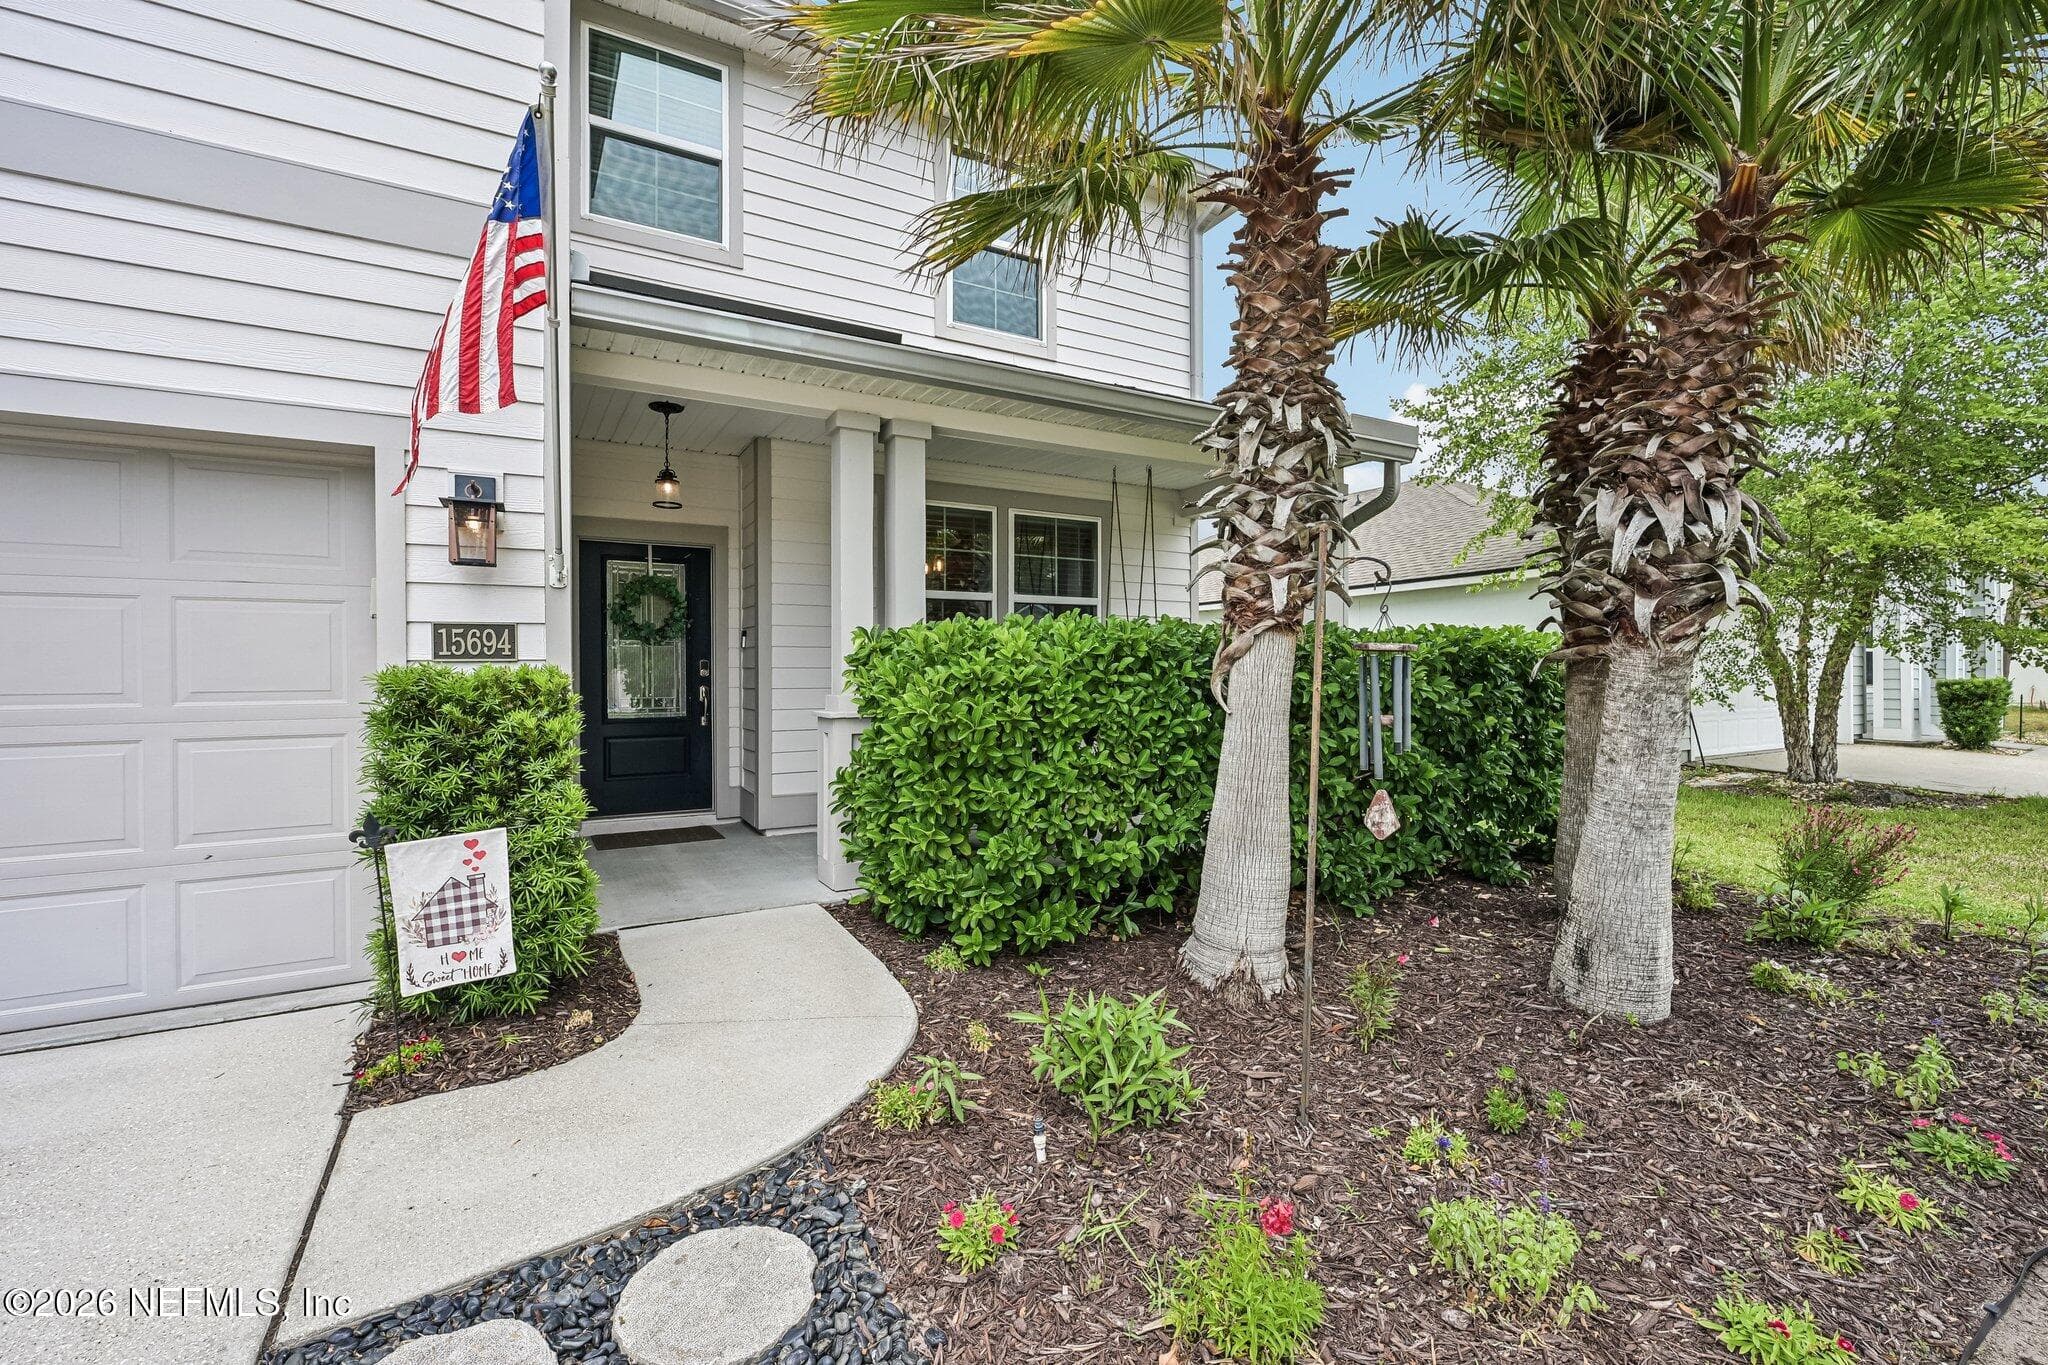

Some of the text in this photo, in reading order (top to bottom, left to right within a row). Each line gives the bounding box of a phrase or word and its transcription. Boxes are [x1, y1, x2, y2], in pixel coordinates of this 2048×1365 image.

[437, 628, 512, 656] 15694
[422, 963, 492, 988] Sweet HOME
